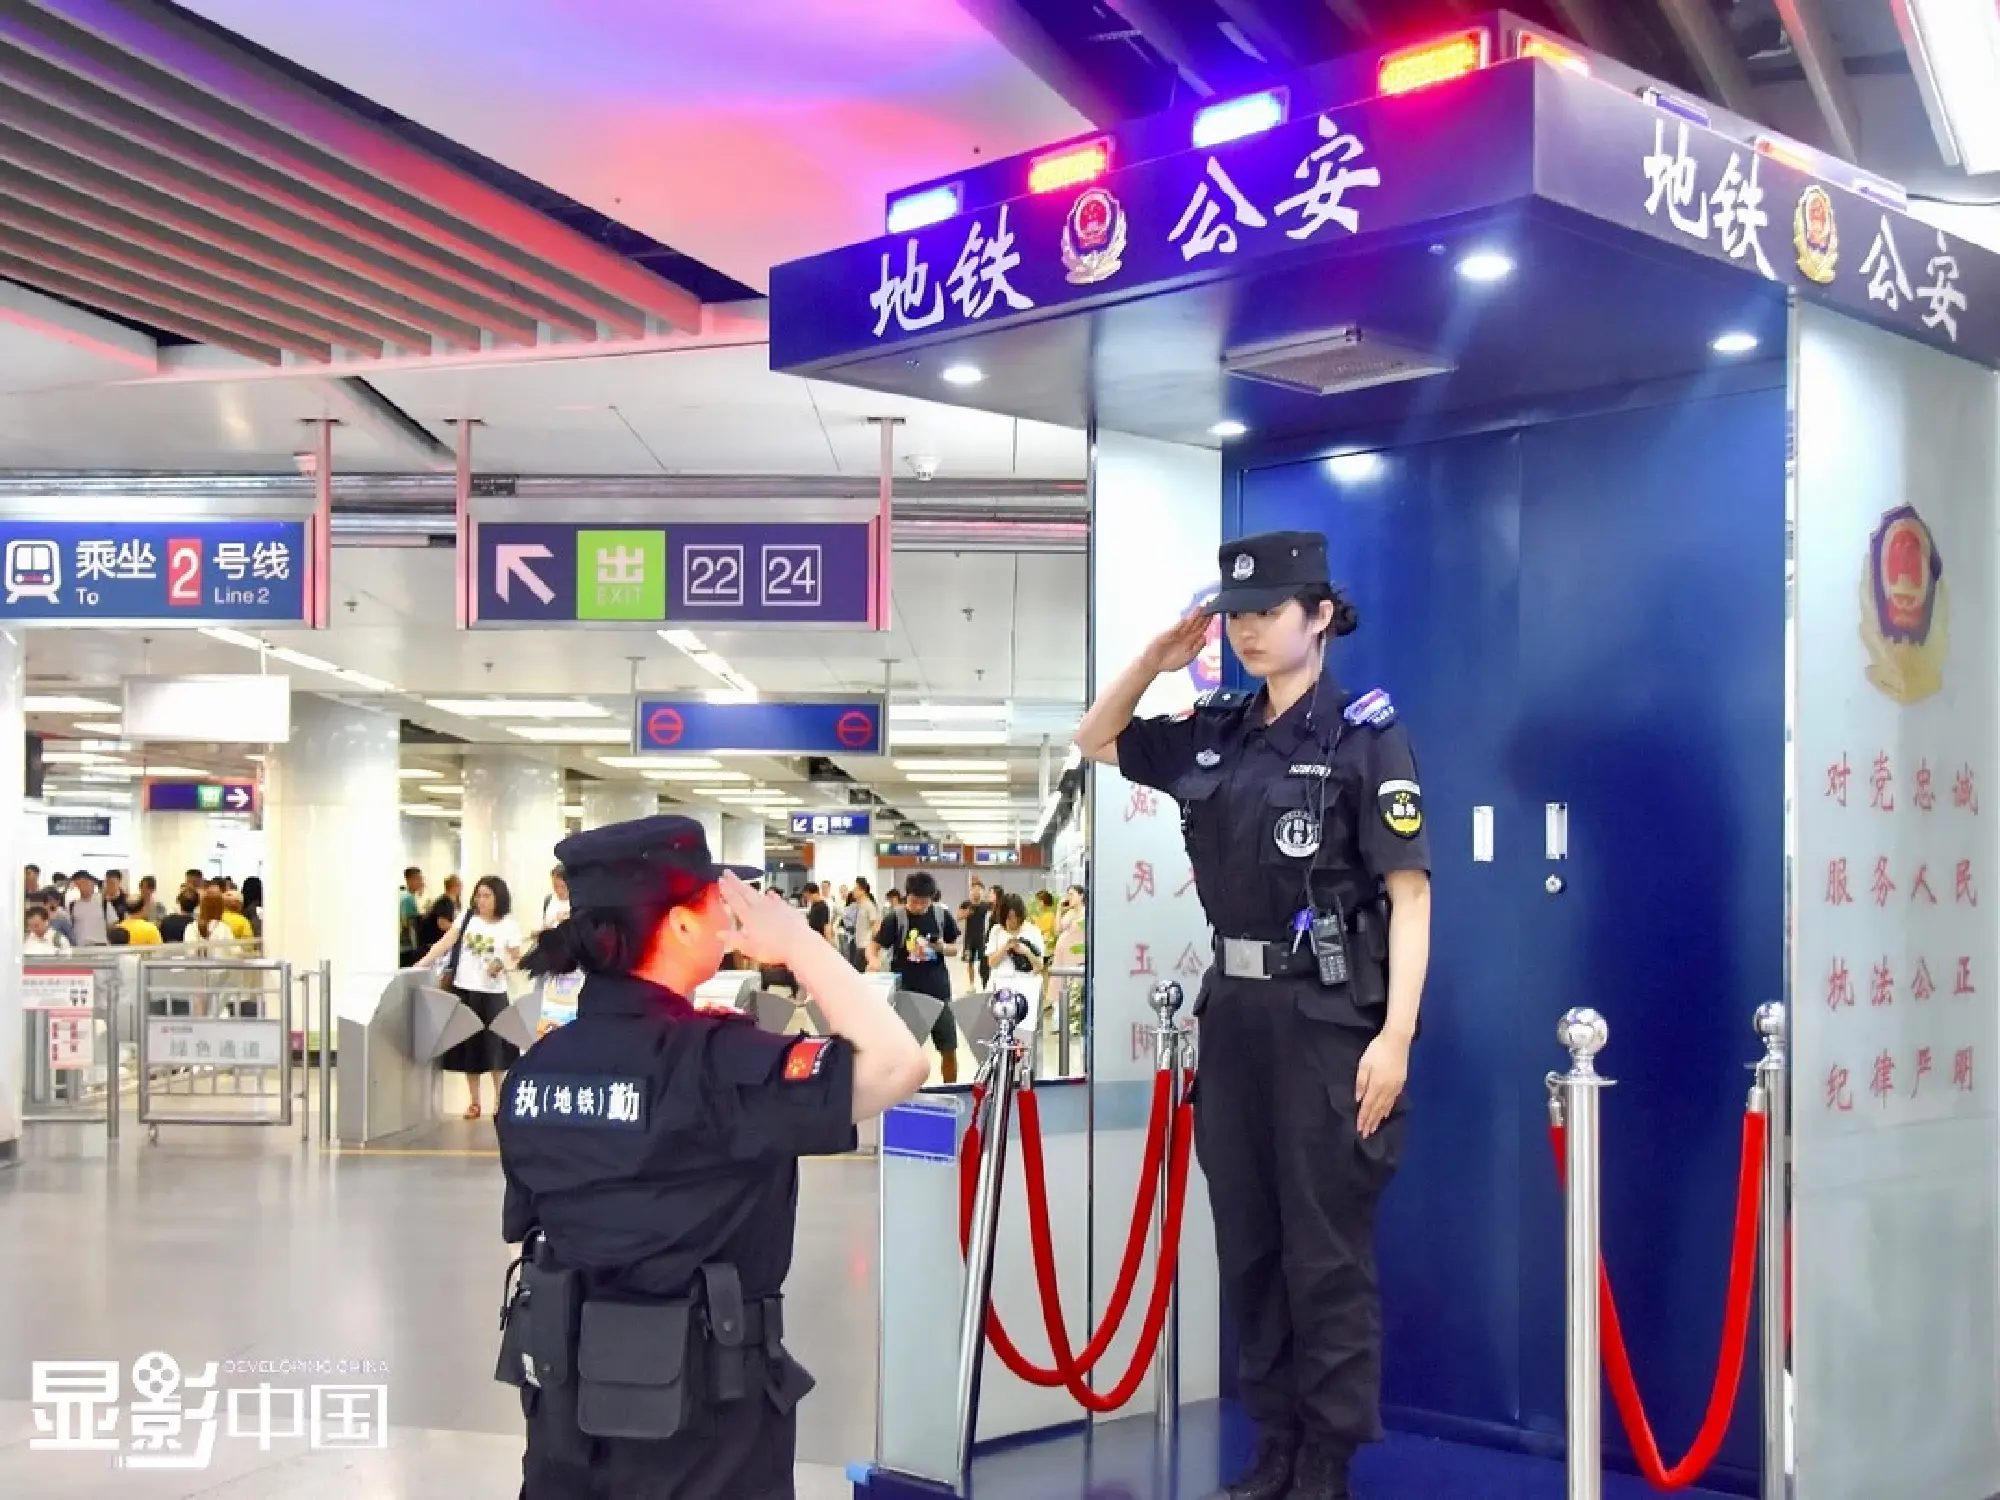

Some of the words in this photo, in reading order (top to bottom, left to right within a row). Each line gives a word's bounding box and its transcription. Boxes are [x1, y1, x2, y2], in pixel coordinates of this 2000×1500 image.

[870, 204, 1034, 336] 地铁
[1168, 114, 1381, 261] 公安
[1643, 119, 1777, 280] 地铁
[1858, 214, 1967, 342] 公安
[75, 538, 157, 580] 乘坐
[171, 547, 200, 599] 2
[213, 541, 290, 580] 号线
[596, 545, 645, 583] 出
[690, 556, 738, 595] 22
[768, 556, 816, 595] 24
[75, 587, 99, 605] To
[214, 587, 254, 605] Line
[257, 587, 270, 605] 2
[597, 586, 644, 605] EXIT
[1824, 750, 1978, 816] 对党忠诚
[1826, 856, 1978, 907] 服务人民
[1827, 955, 1976, 1011] 执法公正
[1826, 1046, 1974, 1110] 纪律严明
